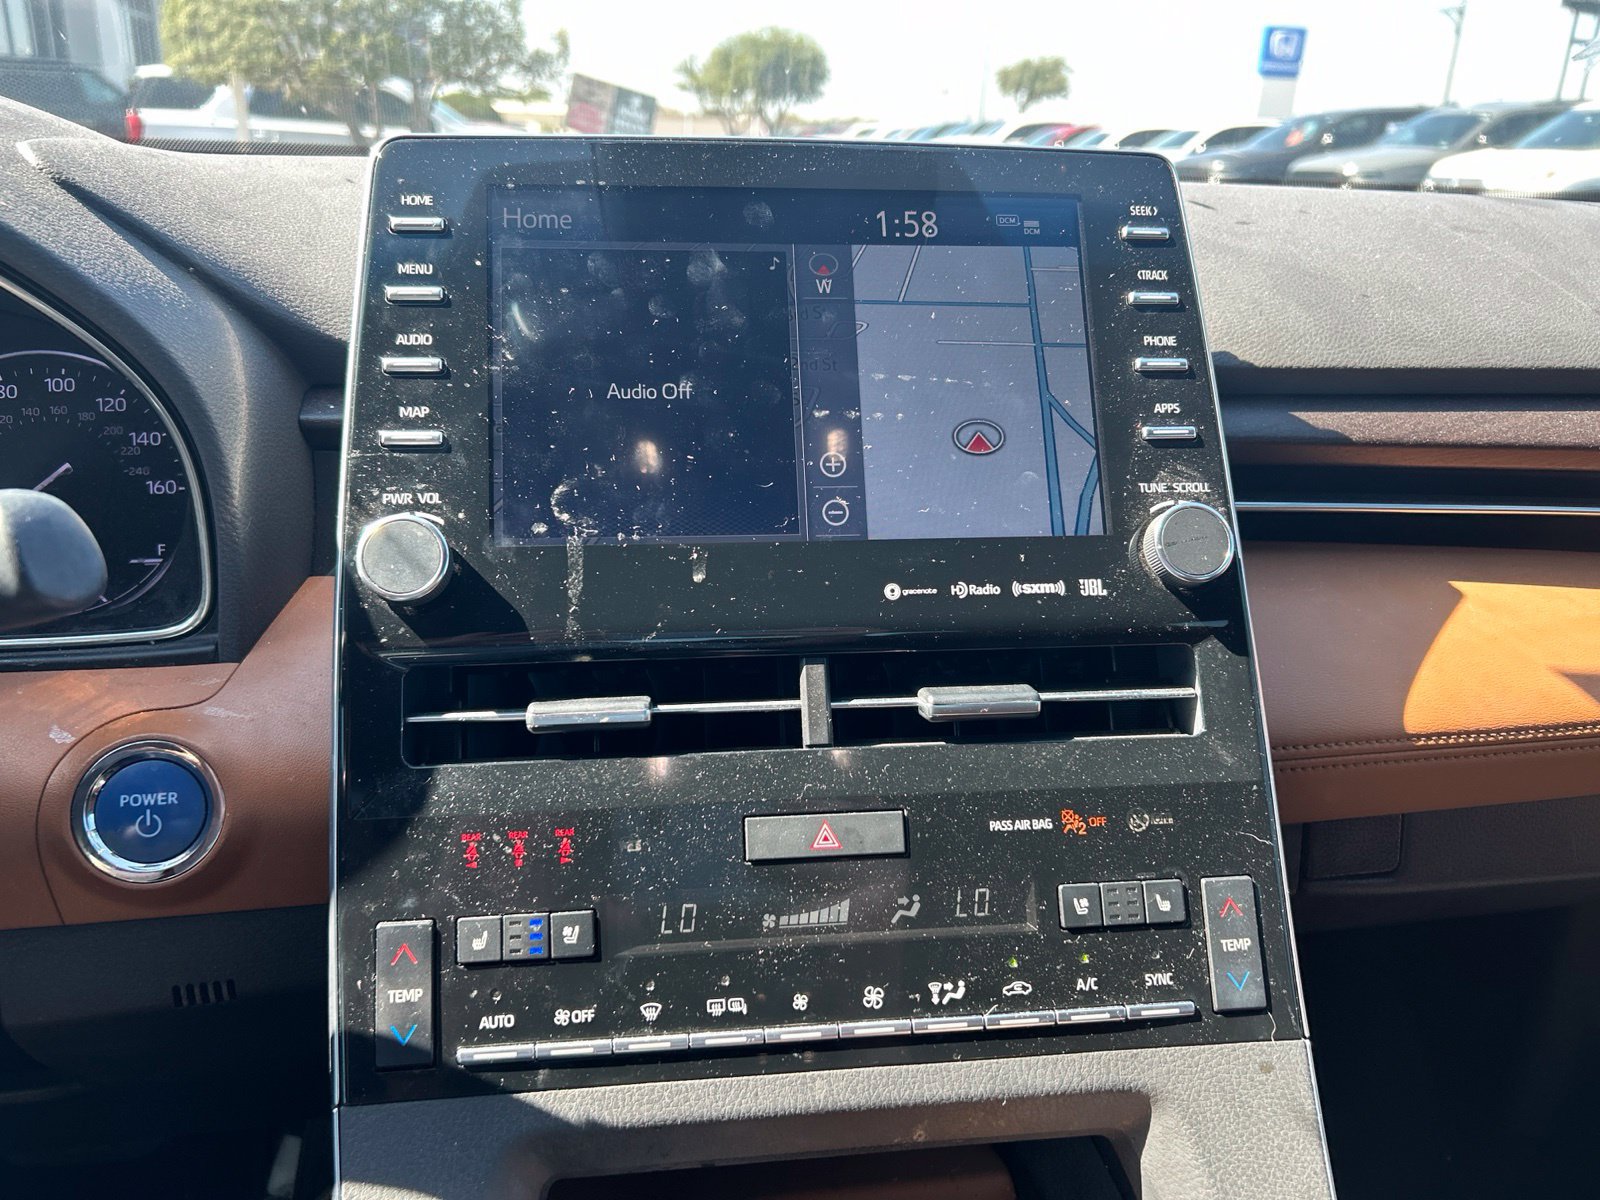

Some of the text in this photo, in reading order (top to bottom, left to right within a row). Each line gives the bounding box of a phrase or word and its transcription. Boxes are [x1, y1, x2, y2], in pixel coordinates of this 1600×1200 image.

[401, 195, 434, 206] HOME
[1130, 206, 1152, 216] SEEK
[503, 207, 573, 230] Home
[876, 210, 939, 238] 1:58
[999, 215, 1016, 225] DCM
[398, 264, 433, 275] MENU
[1141, 270, 1168, 280] TRACK
[816, 279, 832, 294] W
[396, 334, 433, 346] AUDIO
[1144, 336, 1177, 346] PHONE
[823, 359, 838, 372] St
[0, 384, 18, 399] 80
[44, 378, 76, 393] 100
[606, 382, 693, 400] Audio Off
[50, 406, 68, 415] 160
[96, 398, 127, 412] 120
[1154, 403, 1181, 414] APPS
[21, 407, 41, 417] 140
[78, 412, 96, 421] 180
[399, 407, 430, 418] MAP
[103, 426, 124, 435] 200
[129, 432, 162, 446] 140
[121, 447, 141, 456] 220
[129, 466, 150, 476] 240
[146, 480, 177, 495] 160
[1138, 482, 1211, 493] TUNE SCROLL
[382, 491, 443, 505] PWR VOL
[157, 544, 166, 556] F
[902, 587, 938, 596] gracenote
[969, 584, 1001, 595] Radio
[1079, 579, 1107, 596] JBL
[119, 791, 179, 807] POWER
[989, 819, 1053, 832] PASS AIR BAG
[1089, 816, 1107, 827] OFF
[461, 833, 482, 841] REAR
[508, 830, 528, 839] REAR
[554, 828, 575, 837] REAR
[1220, 938, 1251, 952] TEMP
[1076, 977, 1098, 992] A/C
[1145, 973, 1174, 986] SYNC
[387, 989, 423, 1003] TEMP
[479, 1014, 515, 1030] AUTO
[571, 1010, 595, 1024] OFF
